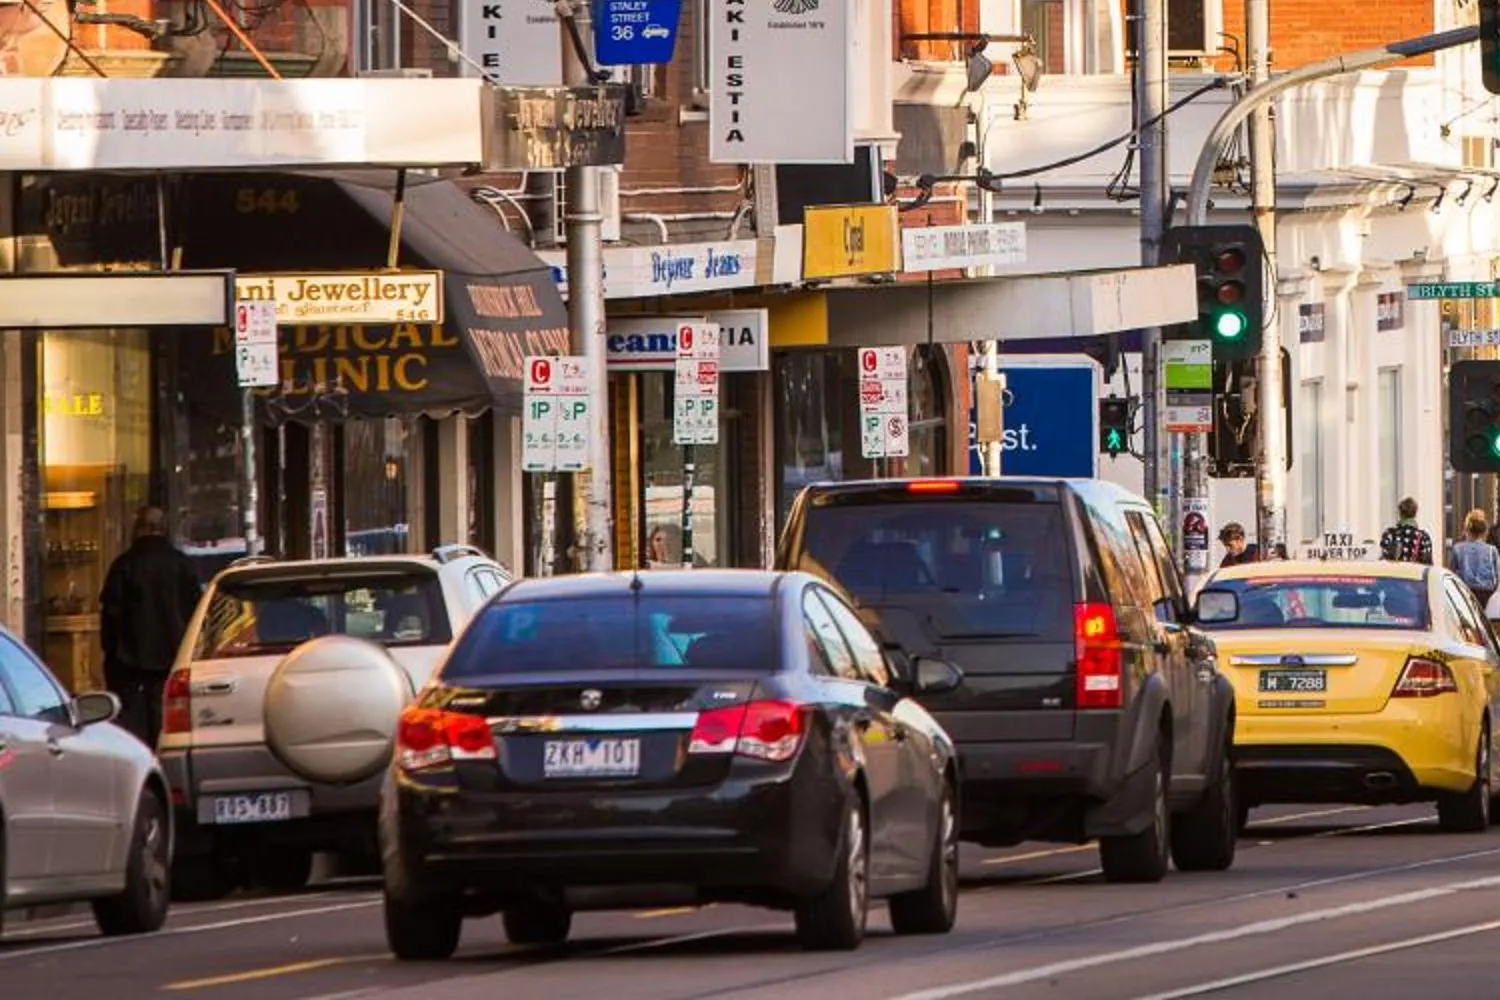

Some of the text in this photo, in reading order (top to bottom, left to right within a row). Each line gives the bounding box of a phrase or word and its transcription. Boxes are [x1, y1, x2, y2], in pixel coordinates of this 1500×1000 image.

[609, 1, 648, 12] STALEY
[611, 12, 650, 23] STREET
[611, 25, 634, 41] 36
[726, 55, 745, 142] ESTIA
[234, 188, 300, 214] 544
[287, 278, 431, 306] Jewellery
[1421, 283, 1496, 298] BLYTH ST
[1323, 533, 1354, 547] TAXI
[1346, 548, 1369, 559] TOP
